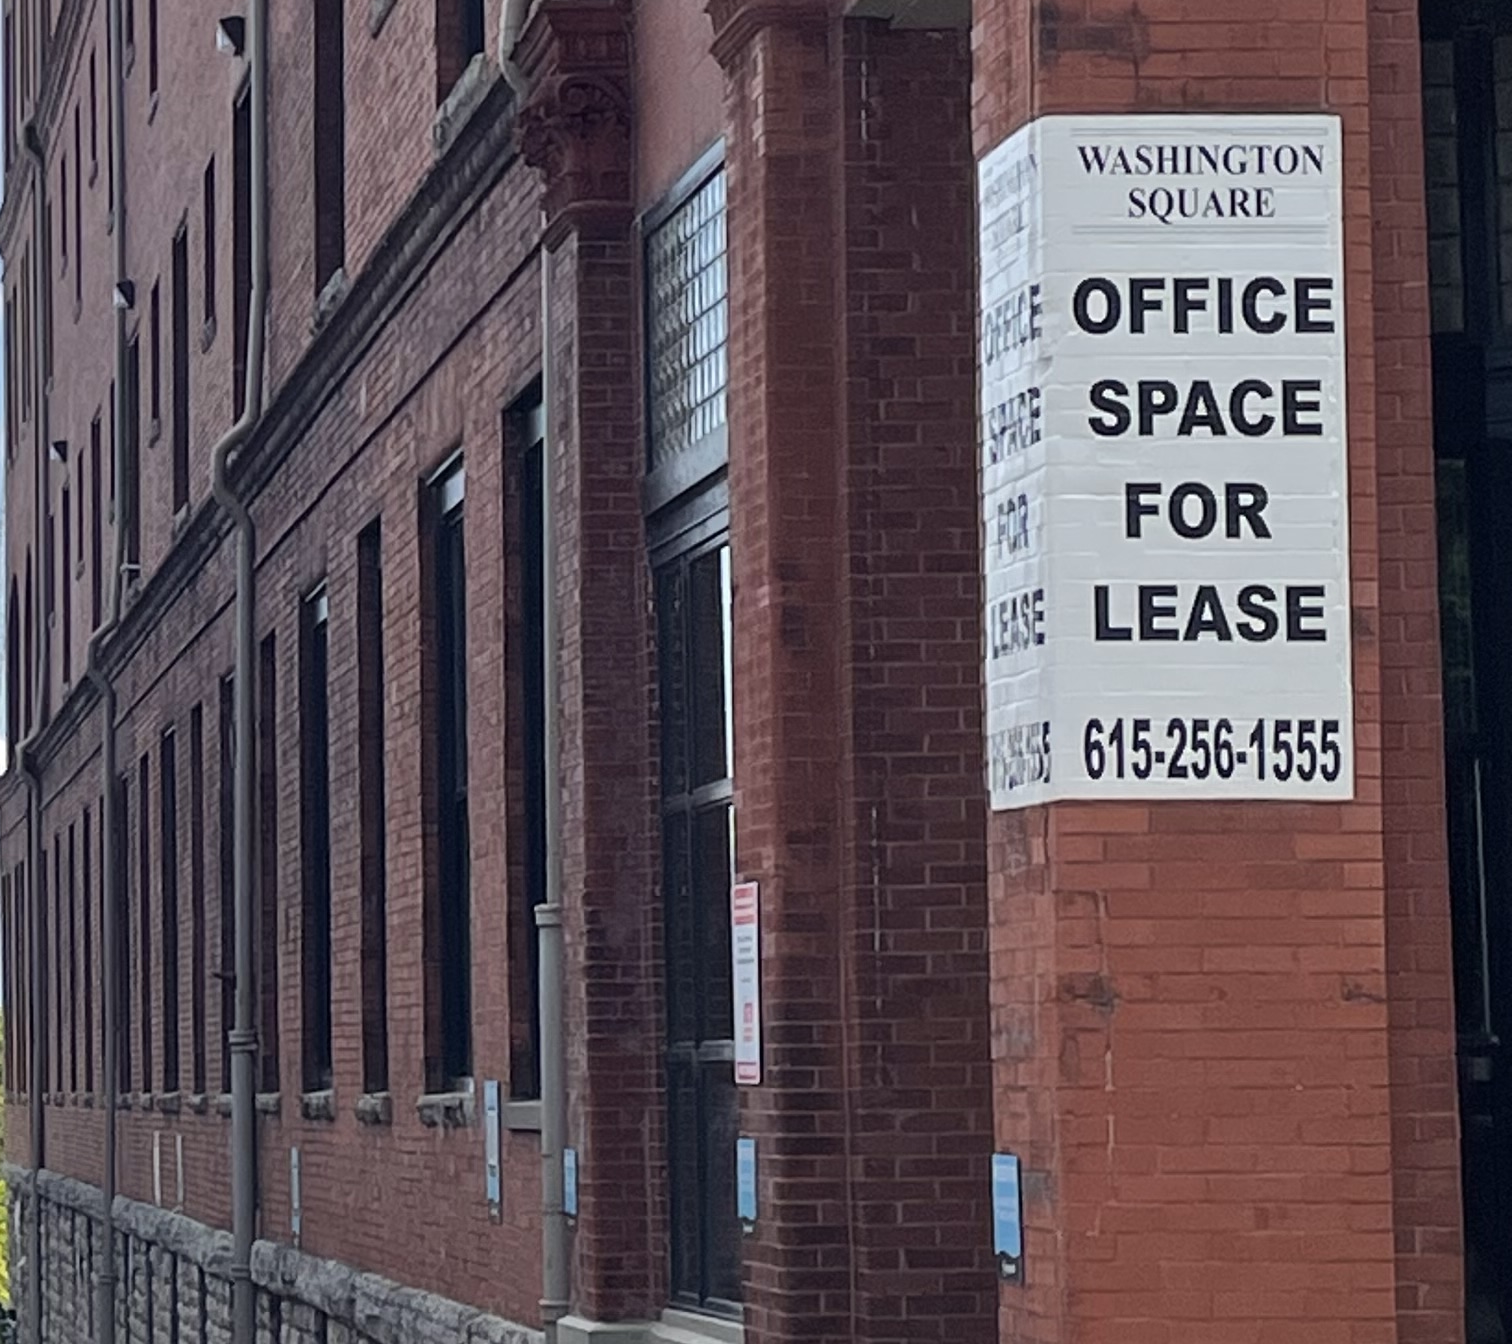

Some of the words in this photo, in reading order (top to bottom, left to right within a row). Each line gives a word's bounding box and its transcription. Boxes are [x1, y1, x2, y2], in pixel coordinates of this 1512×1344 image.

[1078, 144, 1324, 176] WASHINGTON
[1128, 187, 1276, 225] SQUARE
[1073, 277, 1335, 334] OFFICE
[1088, 379, 1323, 437] SPACE
[1125, 482, 1272, 539] FOR
[992, 588, 1044, 659] LEASE
[1094, 585, 1327, 642] LEASE
[1084, 718, 1341, 782] 615-256-1555
